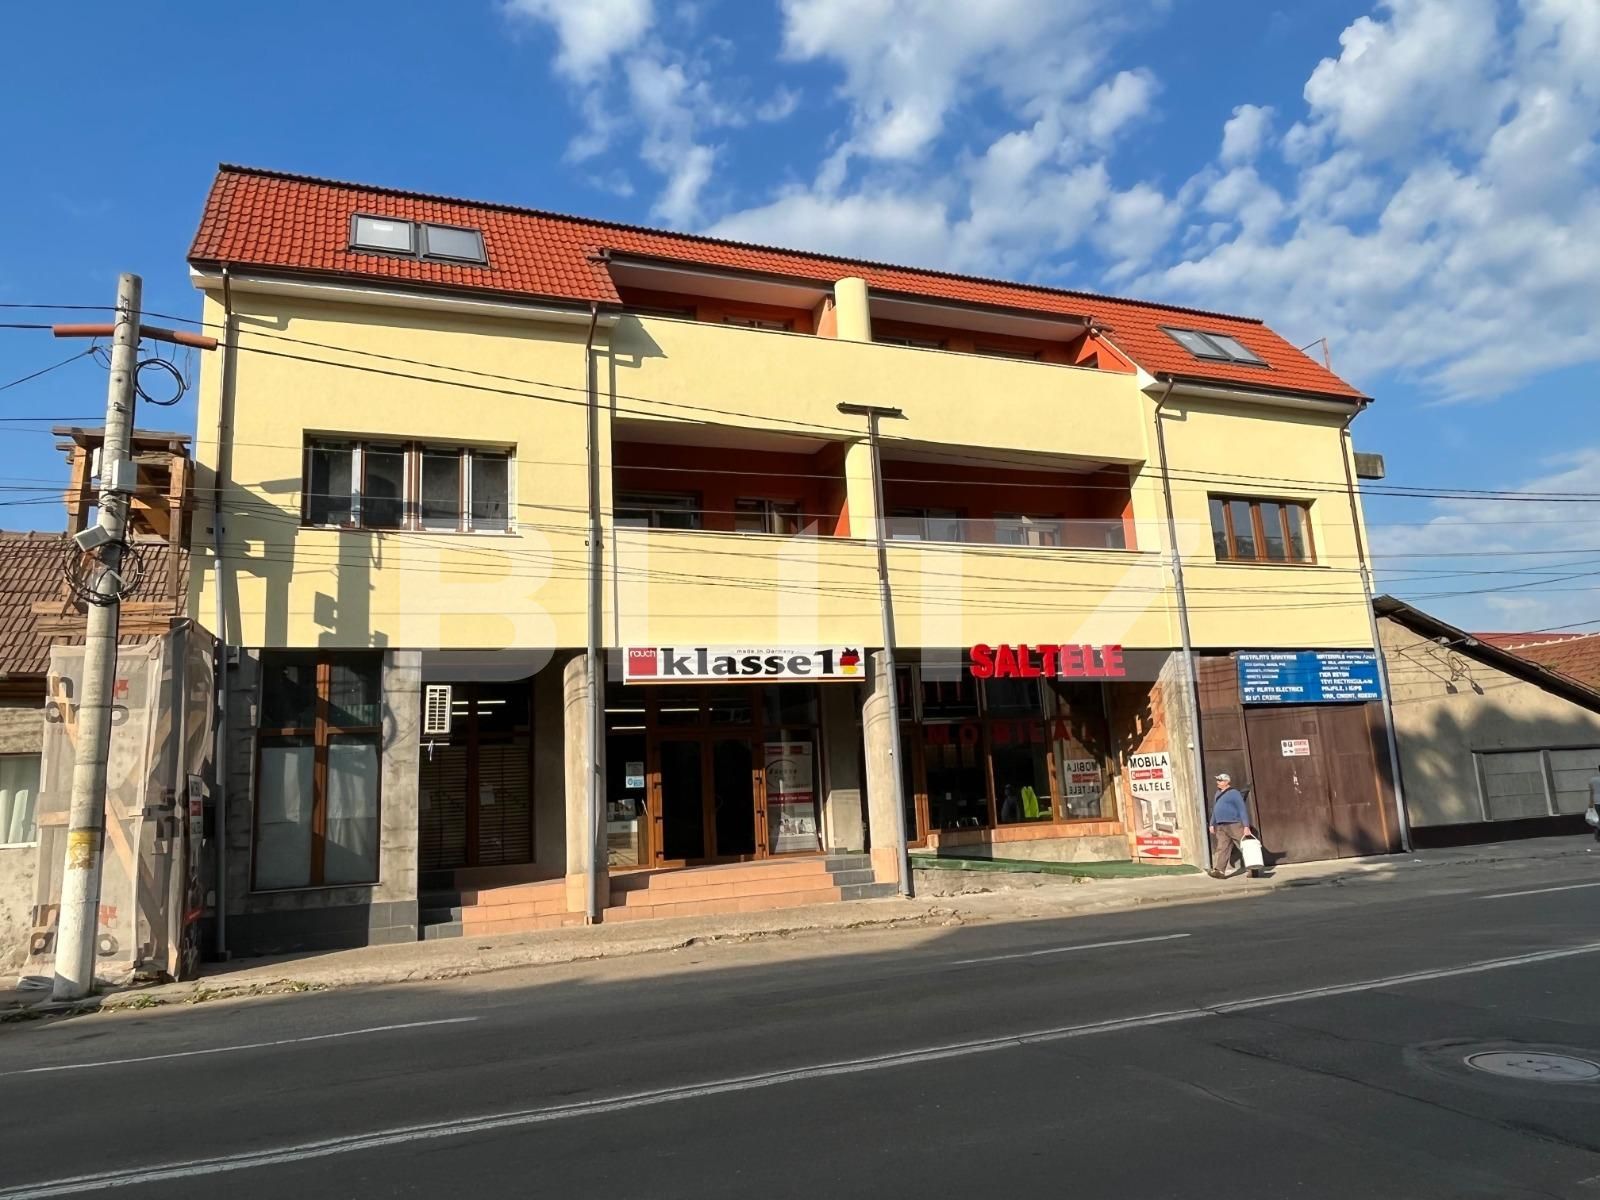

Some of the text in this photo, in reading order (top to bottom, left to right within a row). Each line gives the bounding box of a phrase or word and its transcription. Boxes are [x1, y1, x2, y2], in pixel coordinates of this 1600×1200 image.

[660, 648, 834, 675] klasse1
[970, 643, 1125, 678] SALTELE
[1129, 755, 1168, 769] MOBILA
[1132, 781, 1171, 792] SALTELE
